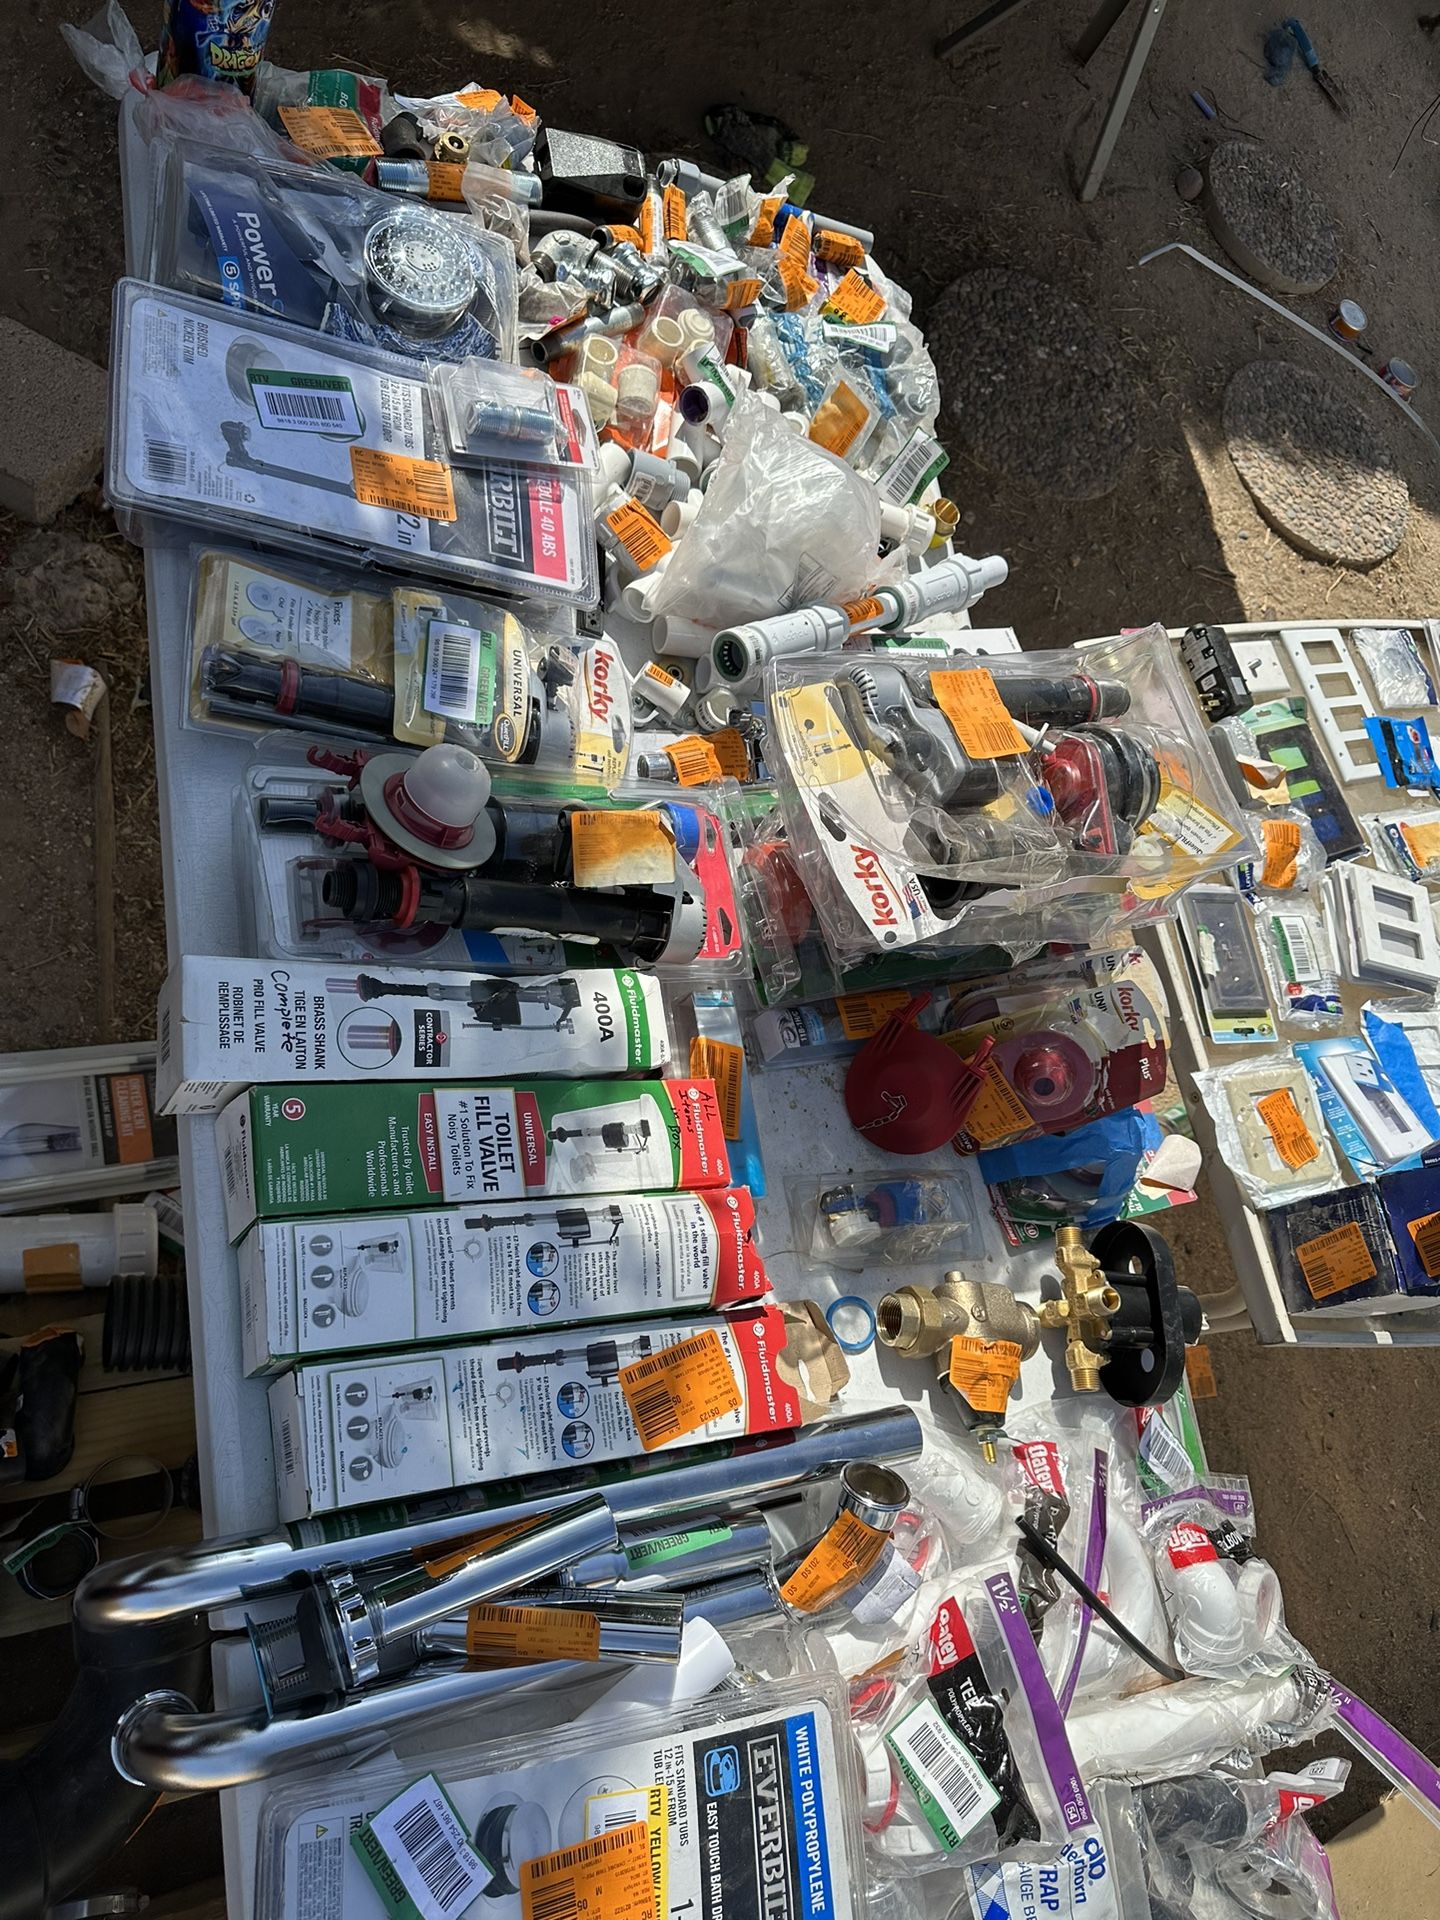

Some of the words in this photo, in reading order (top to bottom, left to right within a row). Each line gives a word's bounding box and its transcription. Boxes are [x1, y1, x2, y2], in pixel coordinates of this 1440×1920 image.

[237, 212, 278, 297] Power
[183, 317, 194, 343] NICKEL
[197, 322, 208, 357] BRUSHED
[183, 344, 194, 365] TRIM
[249, 374, 269, 385] RTV
[290, 377, 350, 392] GREEN/VERT
[379, 377, 389, 389] TUB
[401, 382, 412, 398] FITS
[381, 389, 391, 411] LEDGE
[382, 412, 391, 420] TO
[393, 412, 402, 431] FROM
[402, 398, 414, 430] STANDARD
[382, 421, 392, 443] FLOOR
[405, 431, 415, 449] TUBS
[489, 473, 517, 553] RBILT
[540, 516, 555, 532] 40
[397, 530, 416, 546] in
[541, 533, 556, 557] ABS
[333, 602, 343, 625] Fixes:
[482, 631, 492, 649] RTV
[478, 666, 490, 723] GREEN/VERT
[513, 649, 522, 717] UNIVERSAL
[588, 650, 614, 723] korky
[850, 844, 898, 926] korky
[909, 878, 920, 896] USA
[253, 979, 264, 998] PRO
[233, 986, 243, 1028] ROBINET
[254, 1000, 264, 1020] FILL
[271, 970, 296, 1053] Complete
[294, 990, 305, 1013] TIGE
[313, 996, 325, 1031] BRASS
[218, 981, 230, 1049] REMPLISSAGE
[295, 1015, 306, 1029] EN
[593, 992, 614, 1043] 400A
[234, 1030, 244, 1044] DE
[255, 1022, 265, 1053] VALVE
[418, 1025, 426, 1051] SERIES
[295, 1031, 306, 1070] LAITON
[314, 1033, 326, 1070] SHANK
[1139, 1058, 1151, 1079] Plus
[263, 1095, 272, 1127] WARRANTY
[286, 1104, 301, 1114] 5
[458, 1100, 468, 1114] #1
[474, 1095, 490, 1130] FILL
[423, 1112, 434, 1135] EASY
[447, 1114, 459, 1141] Noisy
[388, 1117, 399, 1177] Manufacturers
[401, 1125, 411, 1156] Trusted
[460, 1118, 474, 1158] Solution
[494, 1112, 516, 1173] TOILET
[523, 1112, 537, 1166] UNIVERSAL
[402, 1158, 412, 1169] By
[426, 1136, 437, 1172] INSTALL
[450, 1143, 462, 1176] Toilets
[465, 1160, 474, 1172] To
[478, 1135, 499, 1192] VALVE
[365, 1150, 377, 1197] Worldwide
[377, 1140, 389, 1197] Professionals
[393, 1179, 402, 1196] and
[405, 1171, 414, 1195] Toilet
[466, 1175, 476, 1189] Fix
[692, 1203, 702, 1215] The
[697, 1216, 706, 1227] #1
[698, 1229, 708, 1253] selling
[692, 1245, 700, 1269] world
[700, 1256, 709, 1266] fill
[721, 1331, 729, 1346] The
[724, 1348, 733, 1358] #1
[727, 1397, 737, 1407] DS
[784, 1402, 793, 1423] 400A
[629, 1534, 689, 1561] GREEN/VERT
[801, 1557, 820, 1579] DS102
[787, 1585, 798, 1596] DS
[936, 1608, 959, 1669] Oatey
[653, 1749, 663, 1769] TUB
[664, 1749, 674, 1760] 12
[674, 1745, 684, 1767] FITS
[795, 1726, 813, 1777] WHITE
[649, 1788, 661, 1817] RTV
[675, 1769, 687, 1819] STANDARD
[667, 1798, 677, 1826] FROM
[706, 1802, 719, 1831] EASY
[1065, 1806, 1076, 1821] 54
[679, 1820, 688, 1847] TUBS
[939, 1824, 960, 1849] RTV
[708, 1832, 721, 1875] TOUCH
[799, 1780, 825, 1914] POLYPROPYLENE
[711, 1876, 722, 1905] BATH
[642, 1909, 652, 1919] RC
